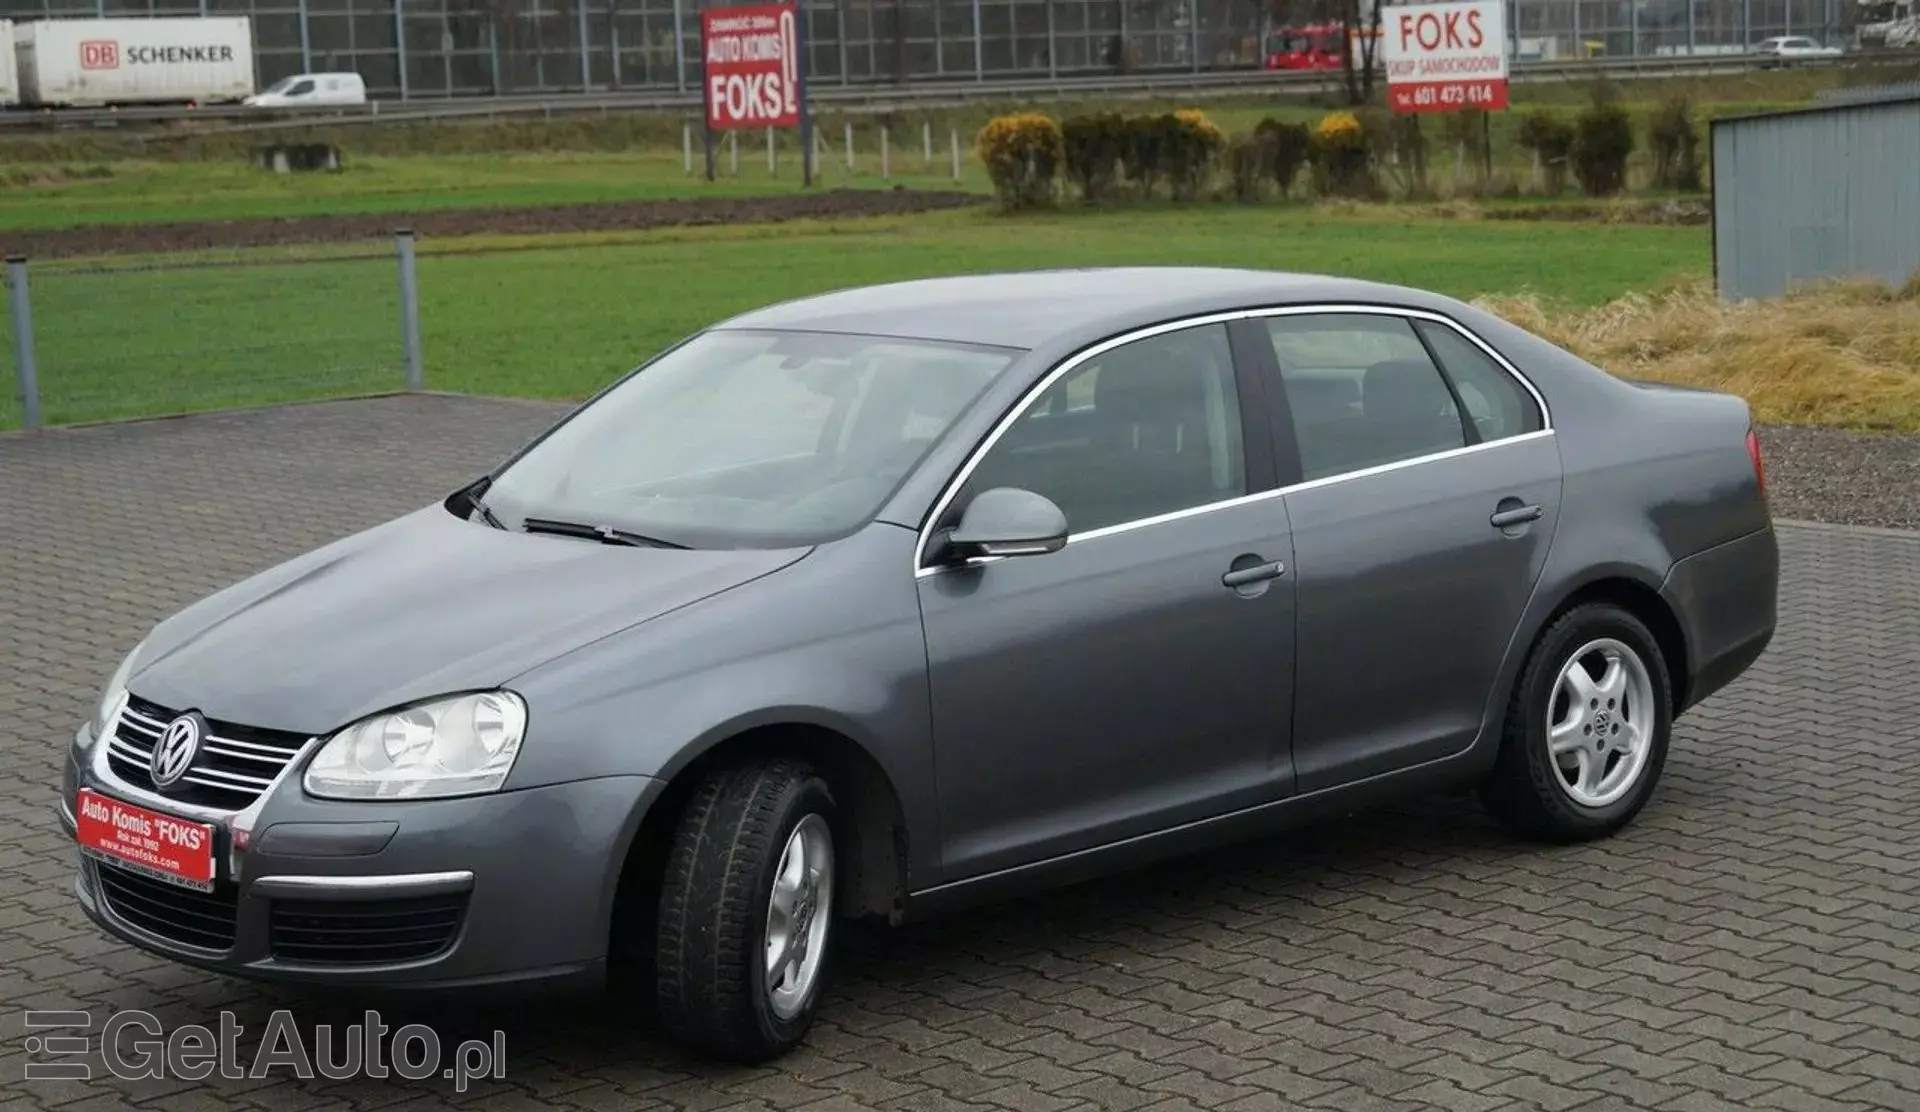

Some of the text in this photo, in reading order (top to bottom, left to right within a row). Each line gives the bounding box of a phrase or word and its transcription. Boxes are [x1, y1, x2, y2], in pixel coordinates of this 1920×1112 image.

[1400, 10, 1484, 52] FOKS
[85, 44, 233, 64] DB SCHENKER
[707, 37, 740, 63] AUTO
[710, 72, 782, 120] FOKS
[82, 796, 205, 850] Auto Komis "FOKS"
[100, 838, 180, 870] www.autofoks.com
